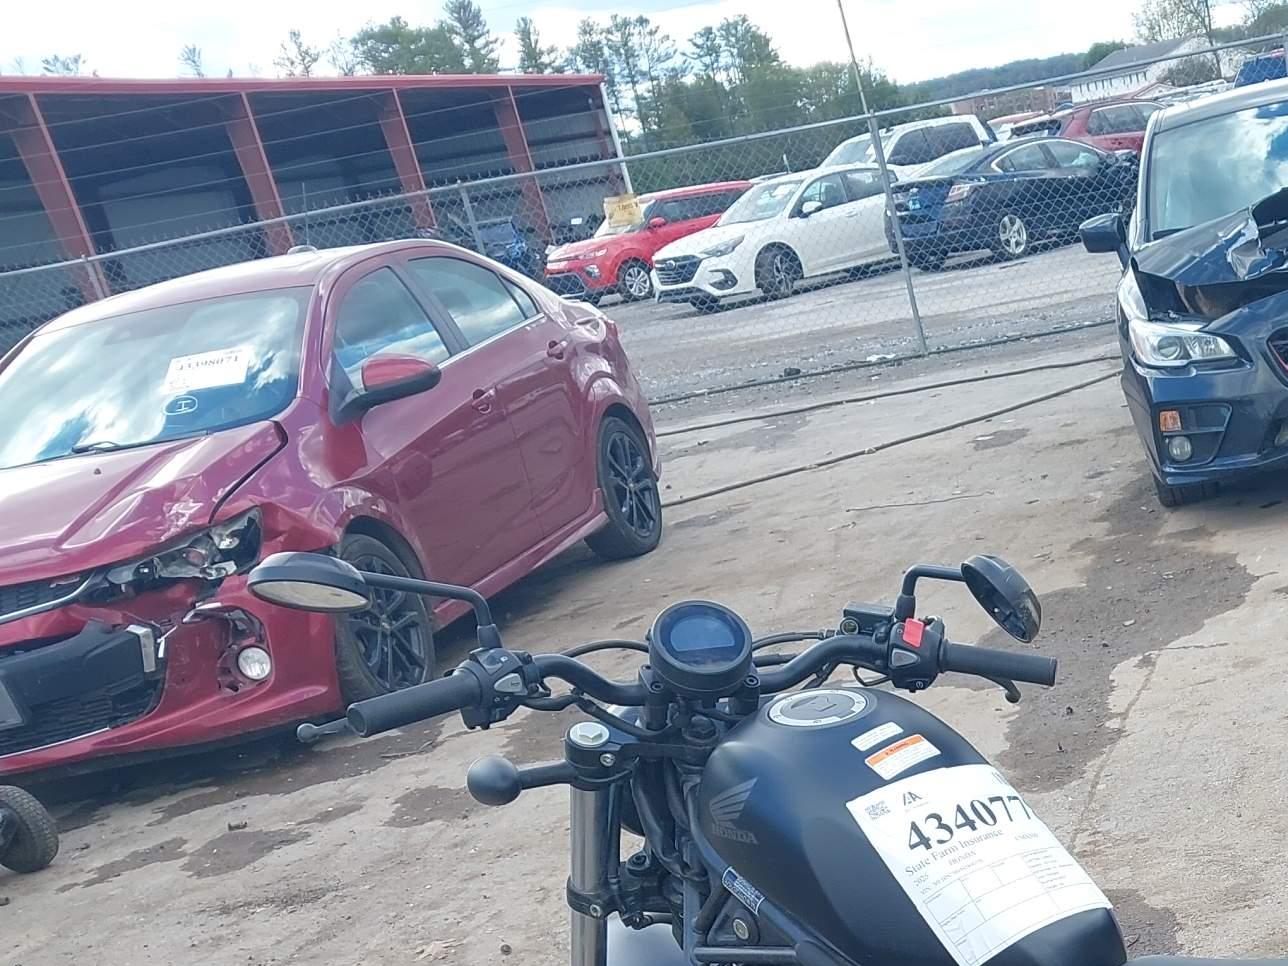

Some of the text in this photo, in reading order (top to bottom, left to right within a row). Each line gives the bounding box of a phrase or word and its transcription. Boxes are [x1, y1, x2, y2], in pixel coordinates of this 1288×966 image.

[711, 822, 760, 845] HONDA
[904, 856, 931, 877] State
[932, 843, 960, 862] Farm
[959, 828, 1005, 849] Insurance
